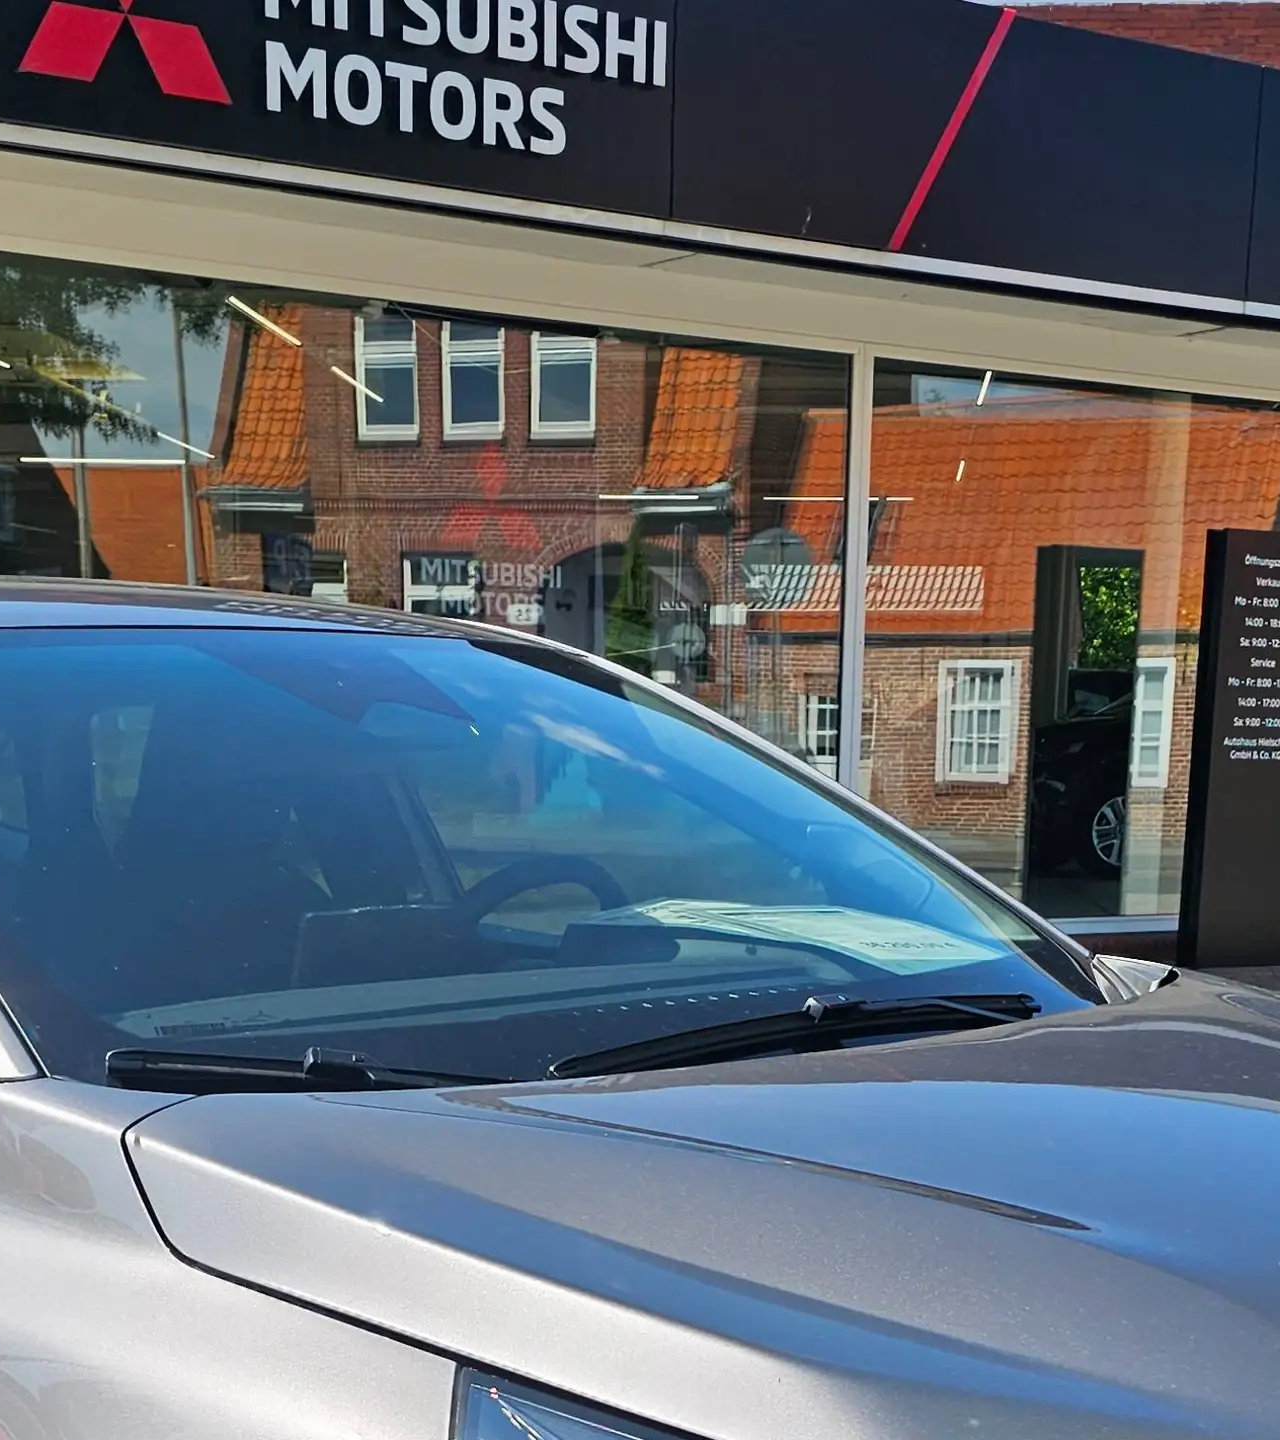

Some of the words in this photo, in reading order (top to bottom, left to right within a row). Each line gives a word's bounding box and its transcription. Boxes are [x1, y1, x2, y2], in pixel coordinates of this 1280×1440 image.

[264, 40, 569, 156] MOTORS
[420, 556, 562, 588] MITSUBISHI
[441, 590, 544, 619] MOTORS
[1234, 596, 1247, 606] Mo
[1245, 617, 1263, 627] 14:00
[1251, 658, 1276, 668] Service
[1228, 677, 1240, 686] Mo
[1238, 698, 1257, 707] 14:00
[1262, 698, 1280, 708] 17:00
[1223, 736, 1257, 747] Autohaus
[1230, 750, 1252, 760] GmbH
